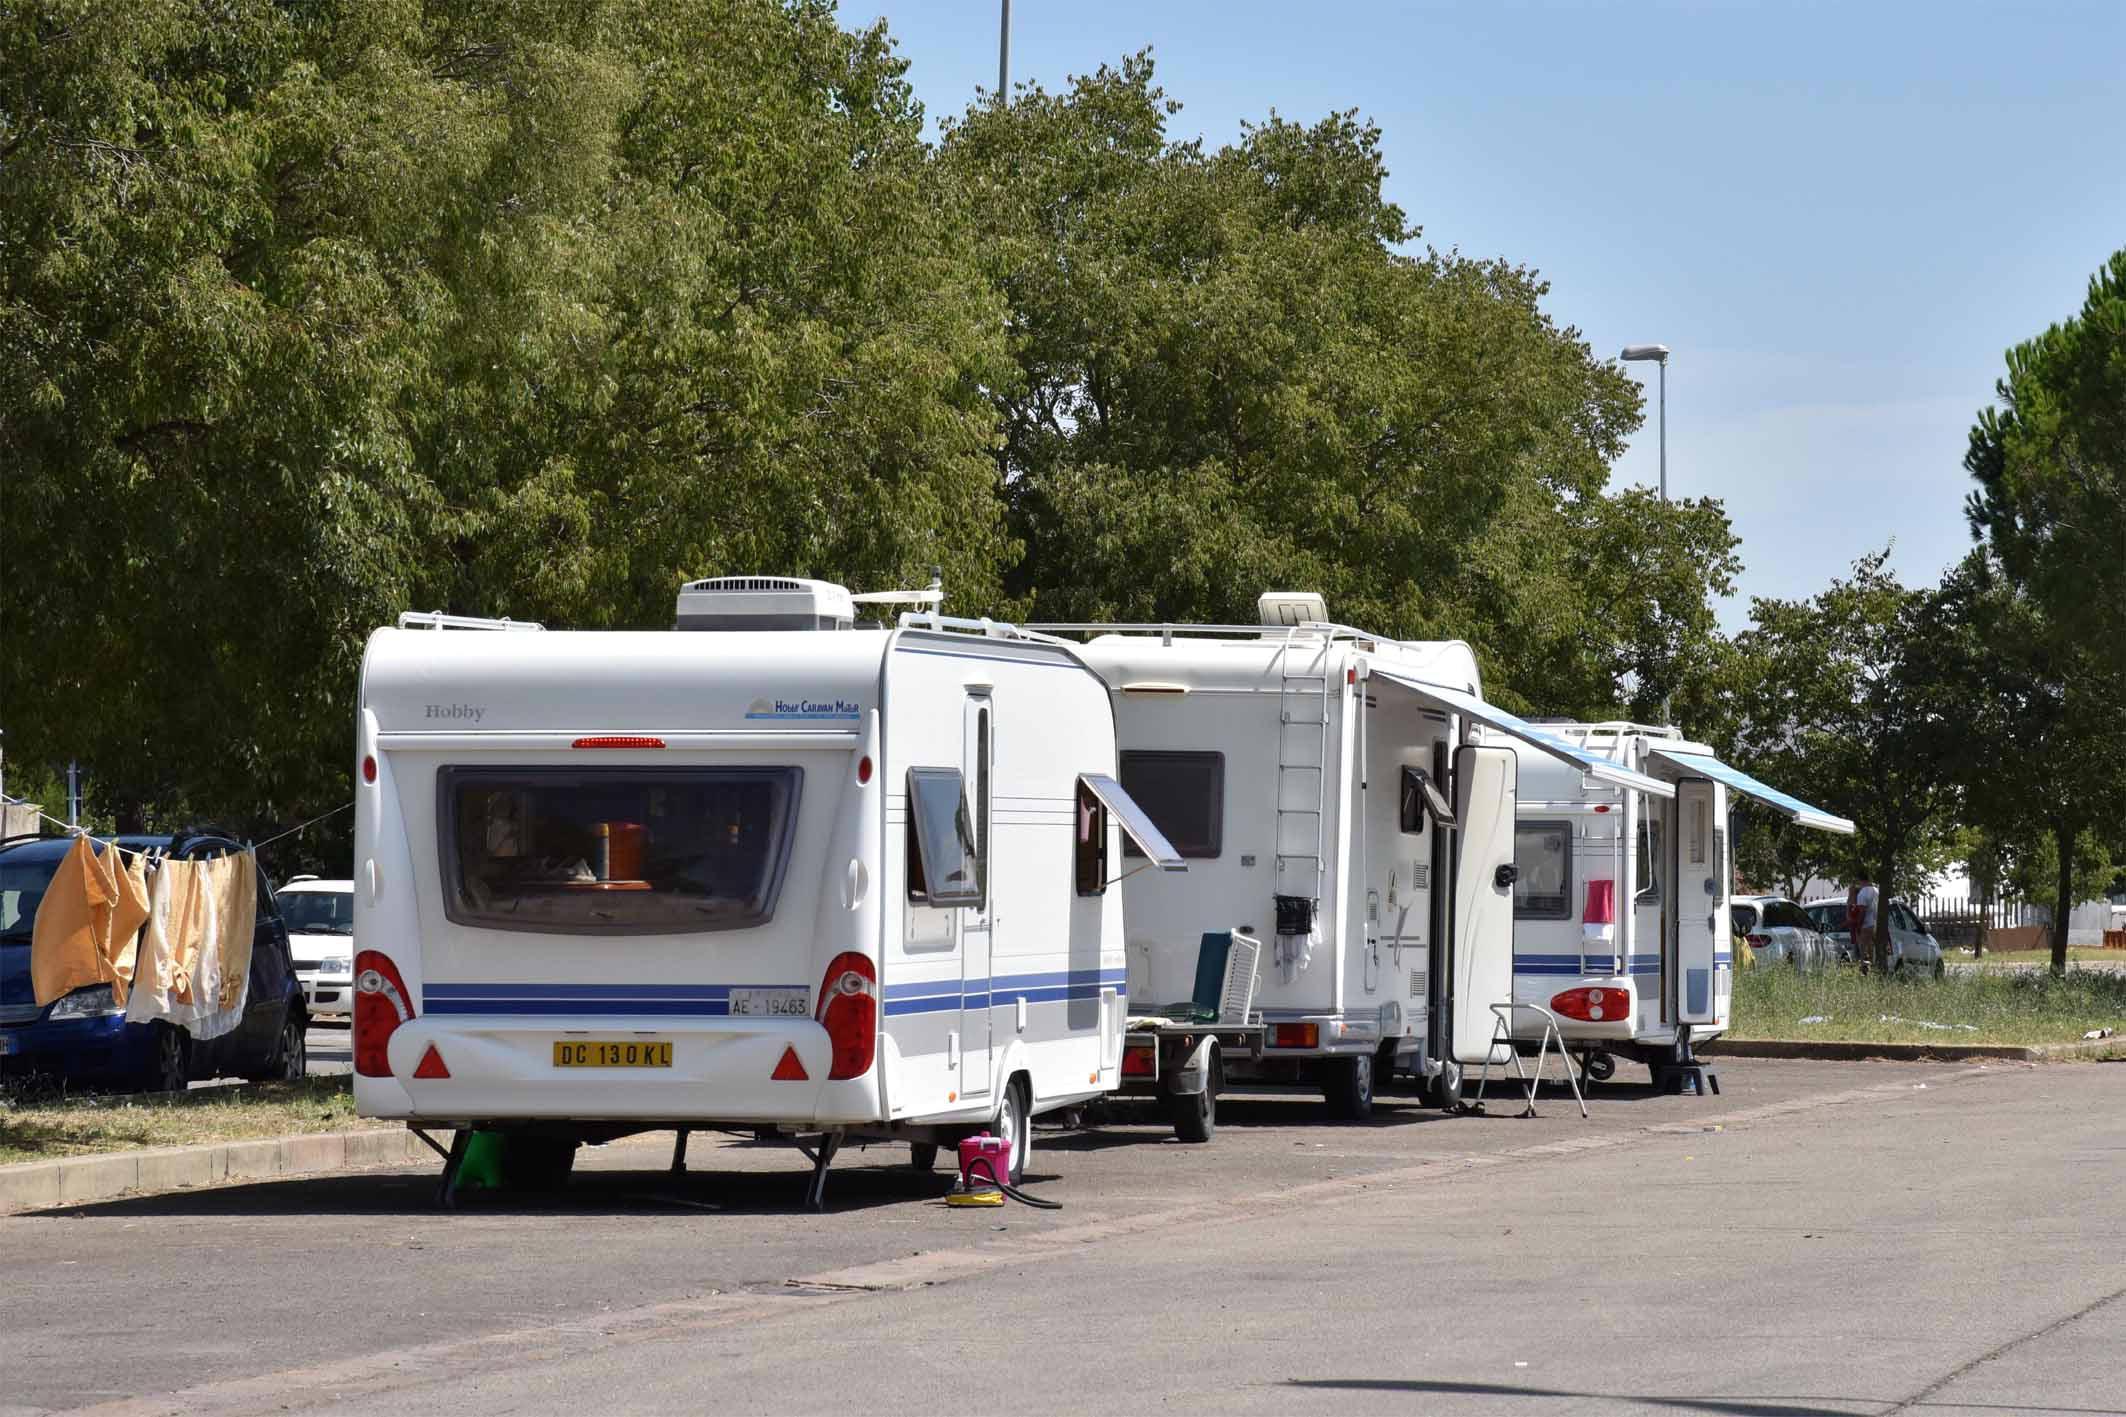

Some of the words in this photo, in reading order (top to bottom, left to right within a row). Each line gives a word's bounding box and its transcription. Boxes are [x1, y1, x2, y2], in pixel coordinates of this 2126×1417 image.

[425, 704, 485, 723] Hobby
[733, 999, 750, 1015] AE
[561, 1045, 587, 1065] DC
